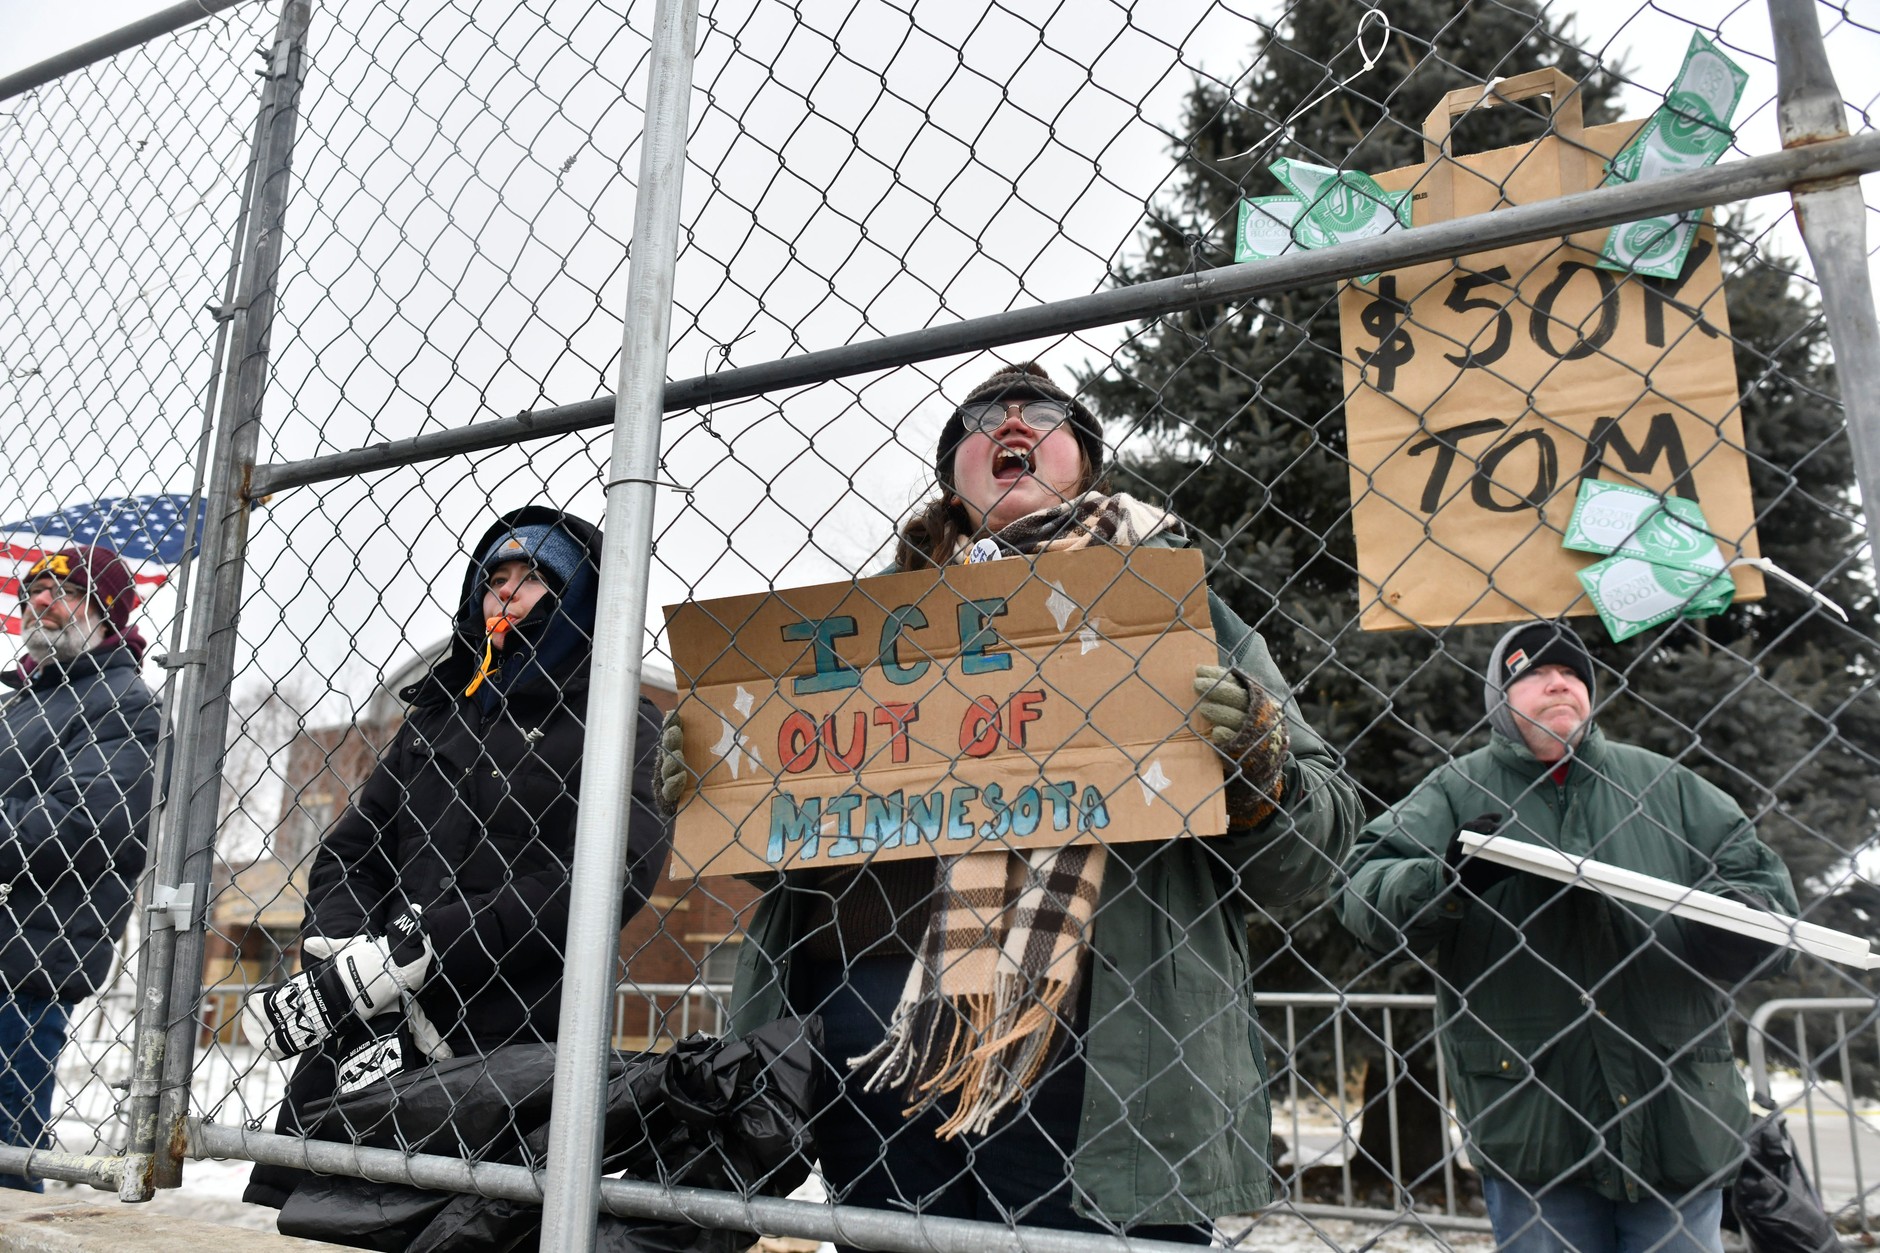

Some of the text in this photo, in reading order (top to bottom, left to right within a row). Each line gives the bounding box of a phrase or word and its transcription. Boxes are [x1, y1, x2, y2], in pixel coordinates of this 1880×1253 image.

[1355, 243, 1719, 393] $50K
[1407, 412, 1700, 513] TOM
[781, 597, 1013, 697] ICE
[778, 689, 1048, 774] OUT OF
[766, 781, 1111, 864] MINNESOTA
